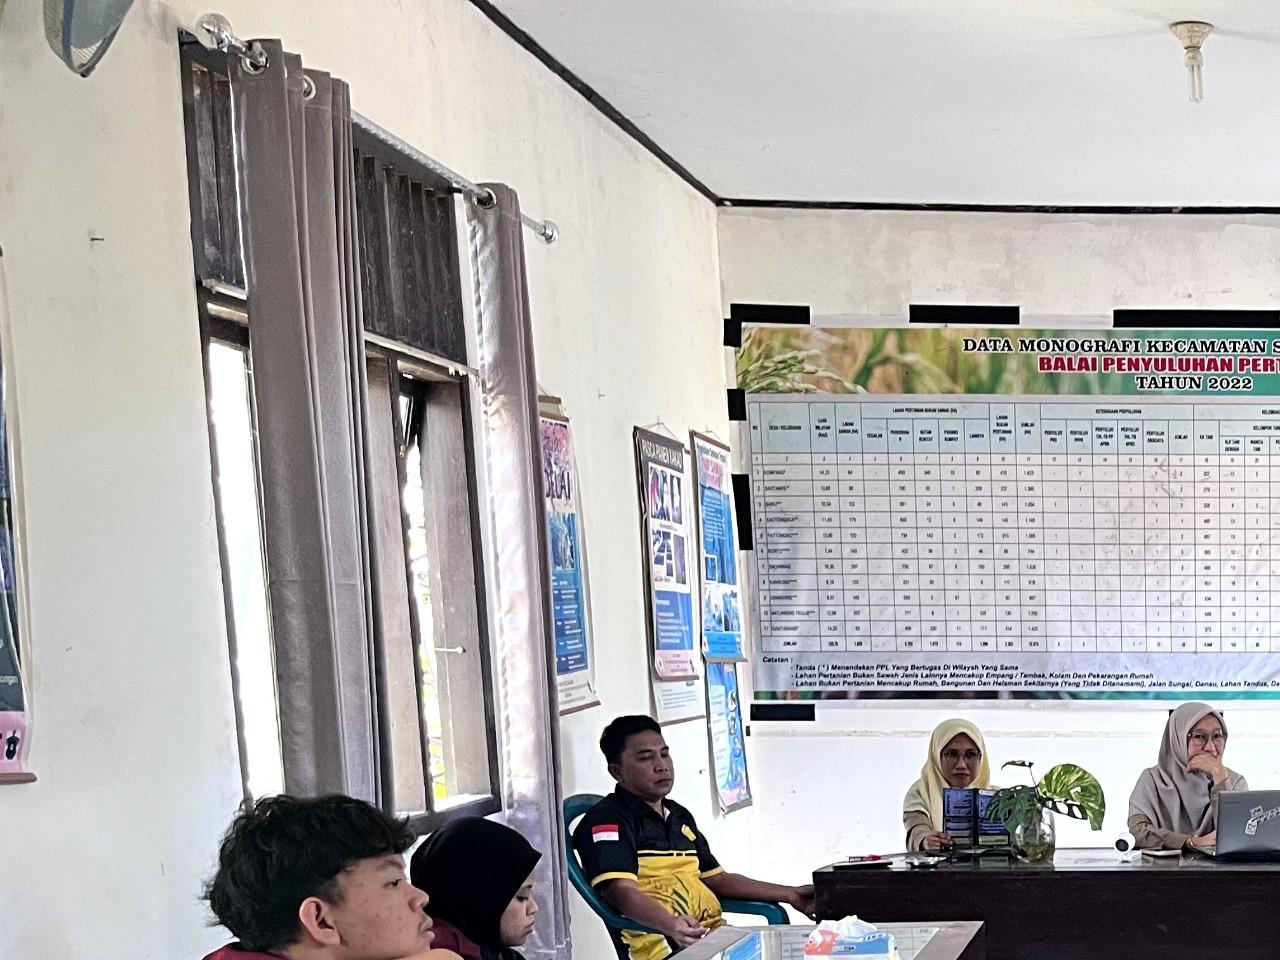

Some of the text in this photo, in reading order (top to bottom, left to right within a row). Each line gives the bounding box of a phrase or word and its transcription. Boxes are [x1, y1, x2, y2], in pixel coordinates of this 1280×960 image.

[962, 338, 1014, 353] DATA
[1018, 338, 1141, 353] MONOGRAFI
[1145, 338, 1268, 353] KECAMATAN
[1038, 357, 1097, 373] BALAI
[1103, 357, 1232, 373] PENYULUHAN
[1135, 375, 1253, 391] TAHUN 2022
